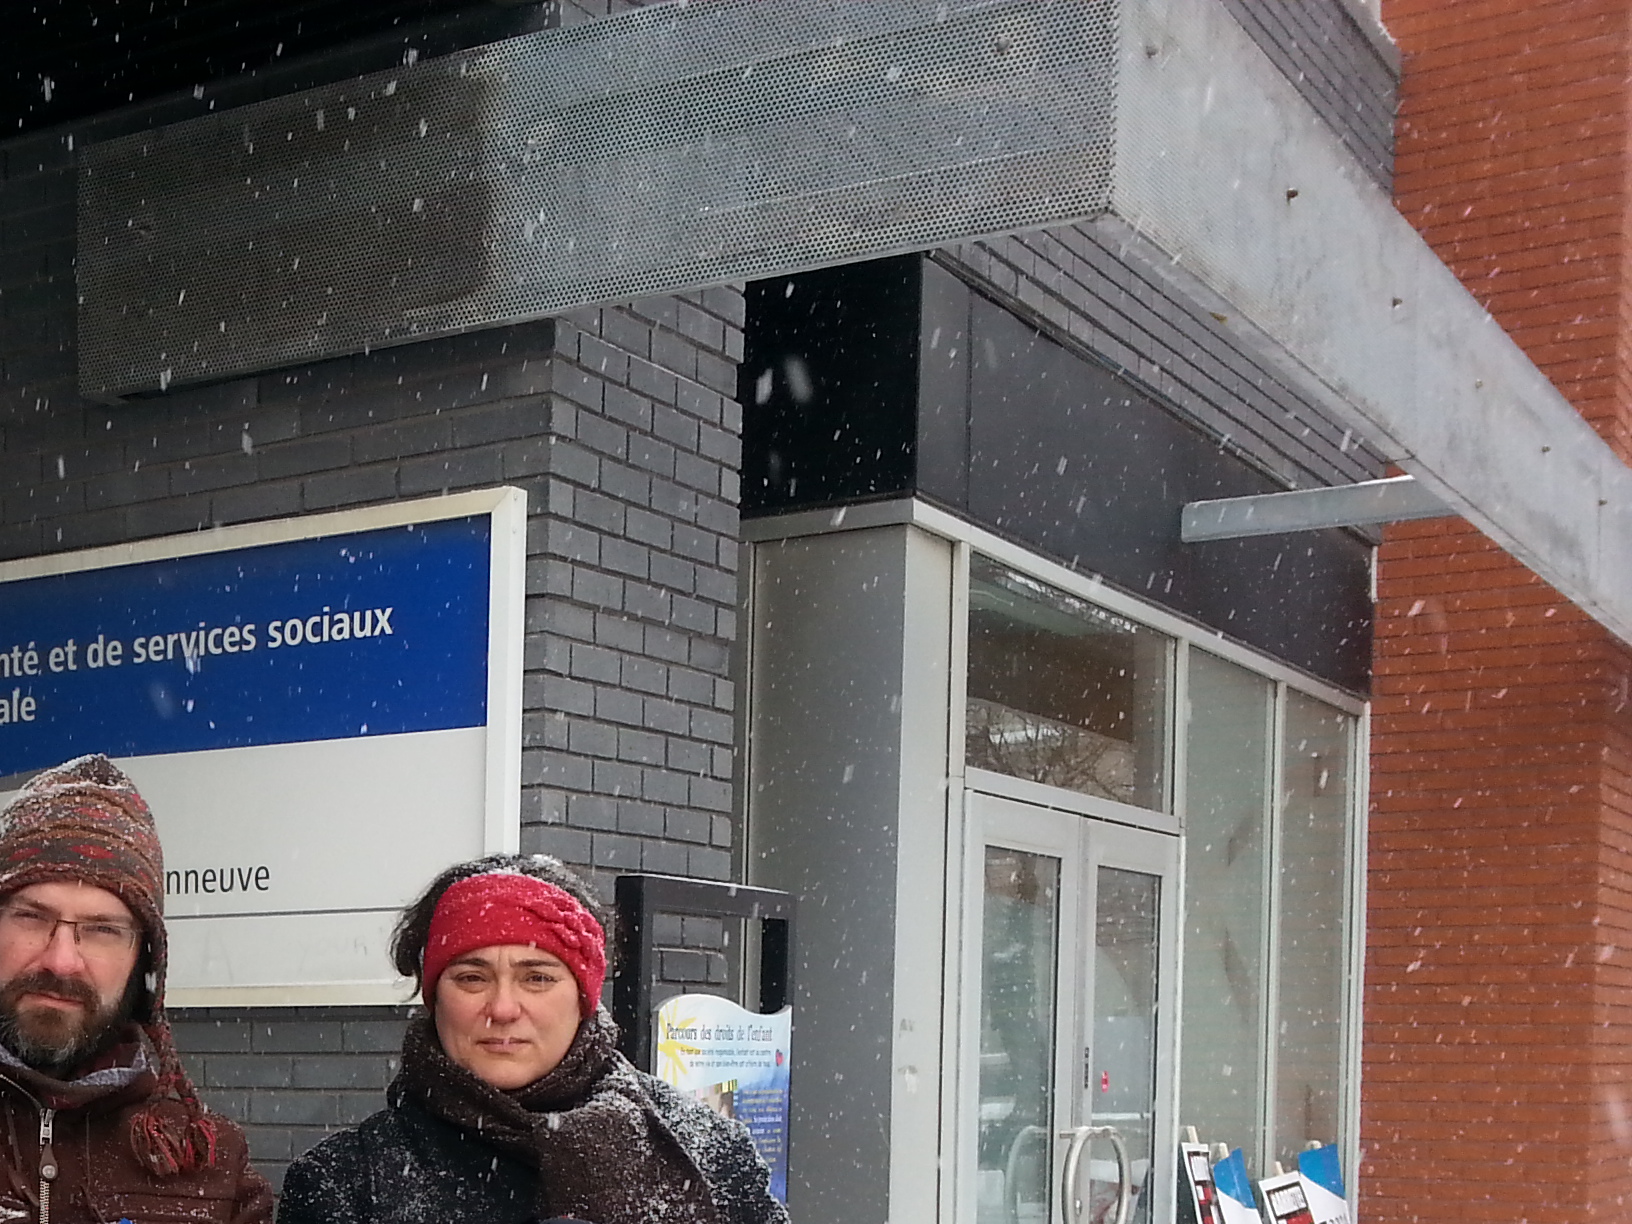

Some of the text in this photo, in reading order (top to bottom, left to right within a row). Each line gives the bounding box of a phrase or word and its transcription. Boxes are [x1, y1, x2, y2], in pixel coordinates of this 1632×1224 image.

[49, 638, 76, 673] et
[87, 634, 122, 668] de
[133, 622, 256, 664] services
[268, 606, 393, 649] sociaux
[165, 866, 270, 895] nneuve
[666, 1023, 698, 1040] Parcours
[700, 1024, 712, 1041] des
